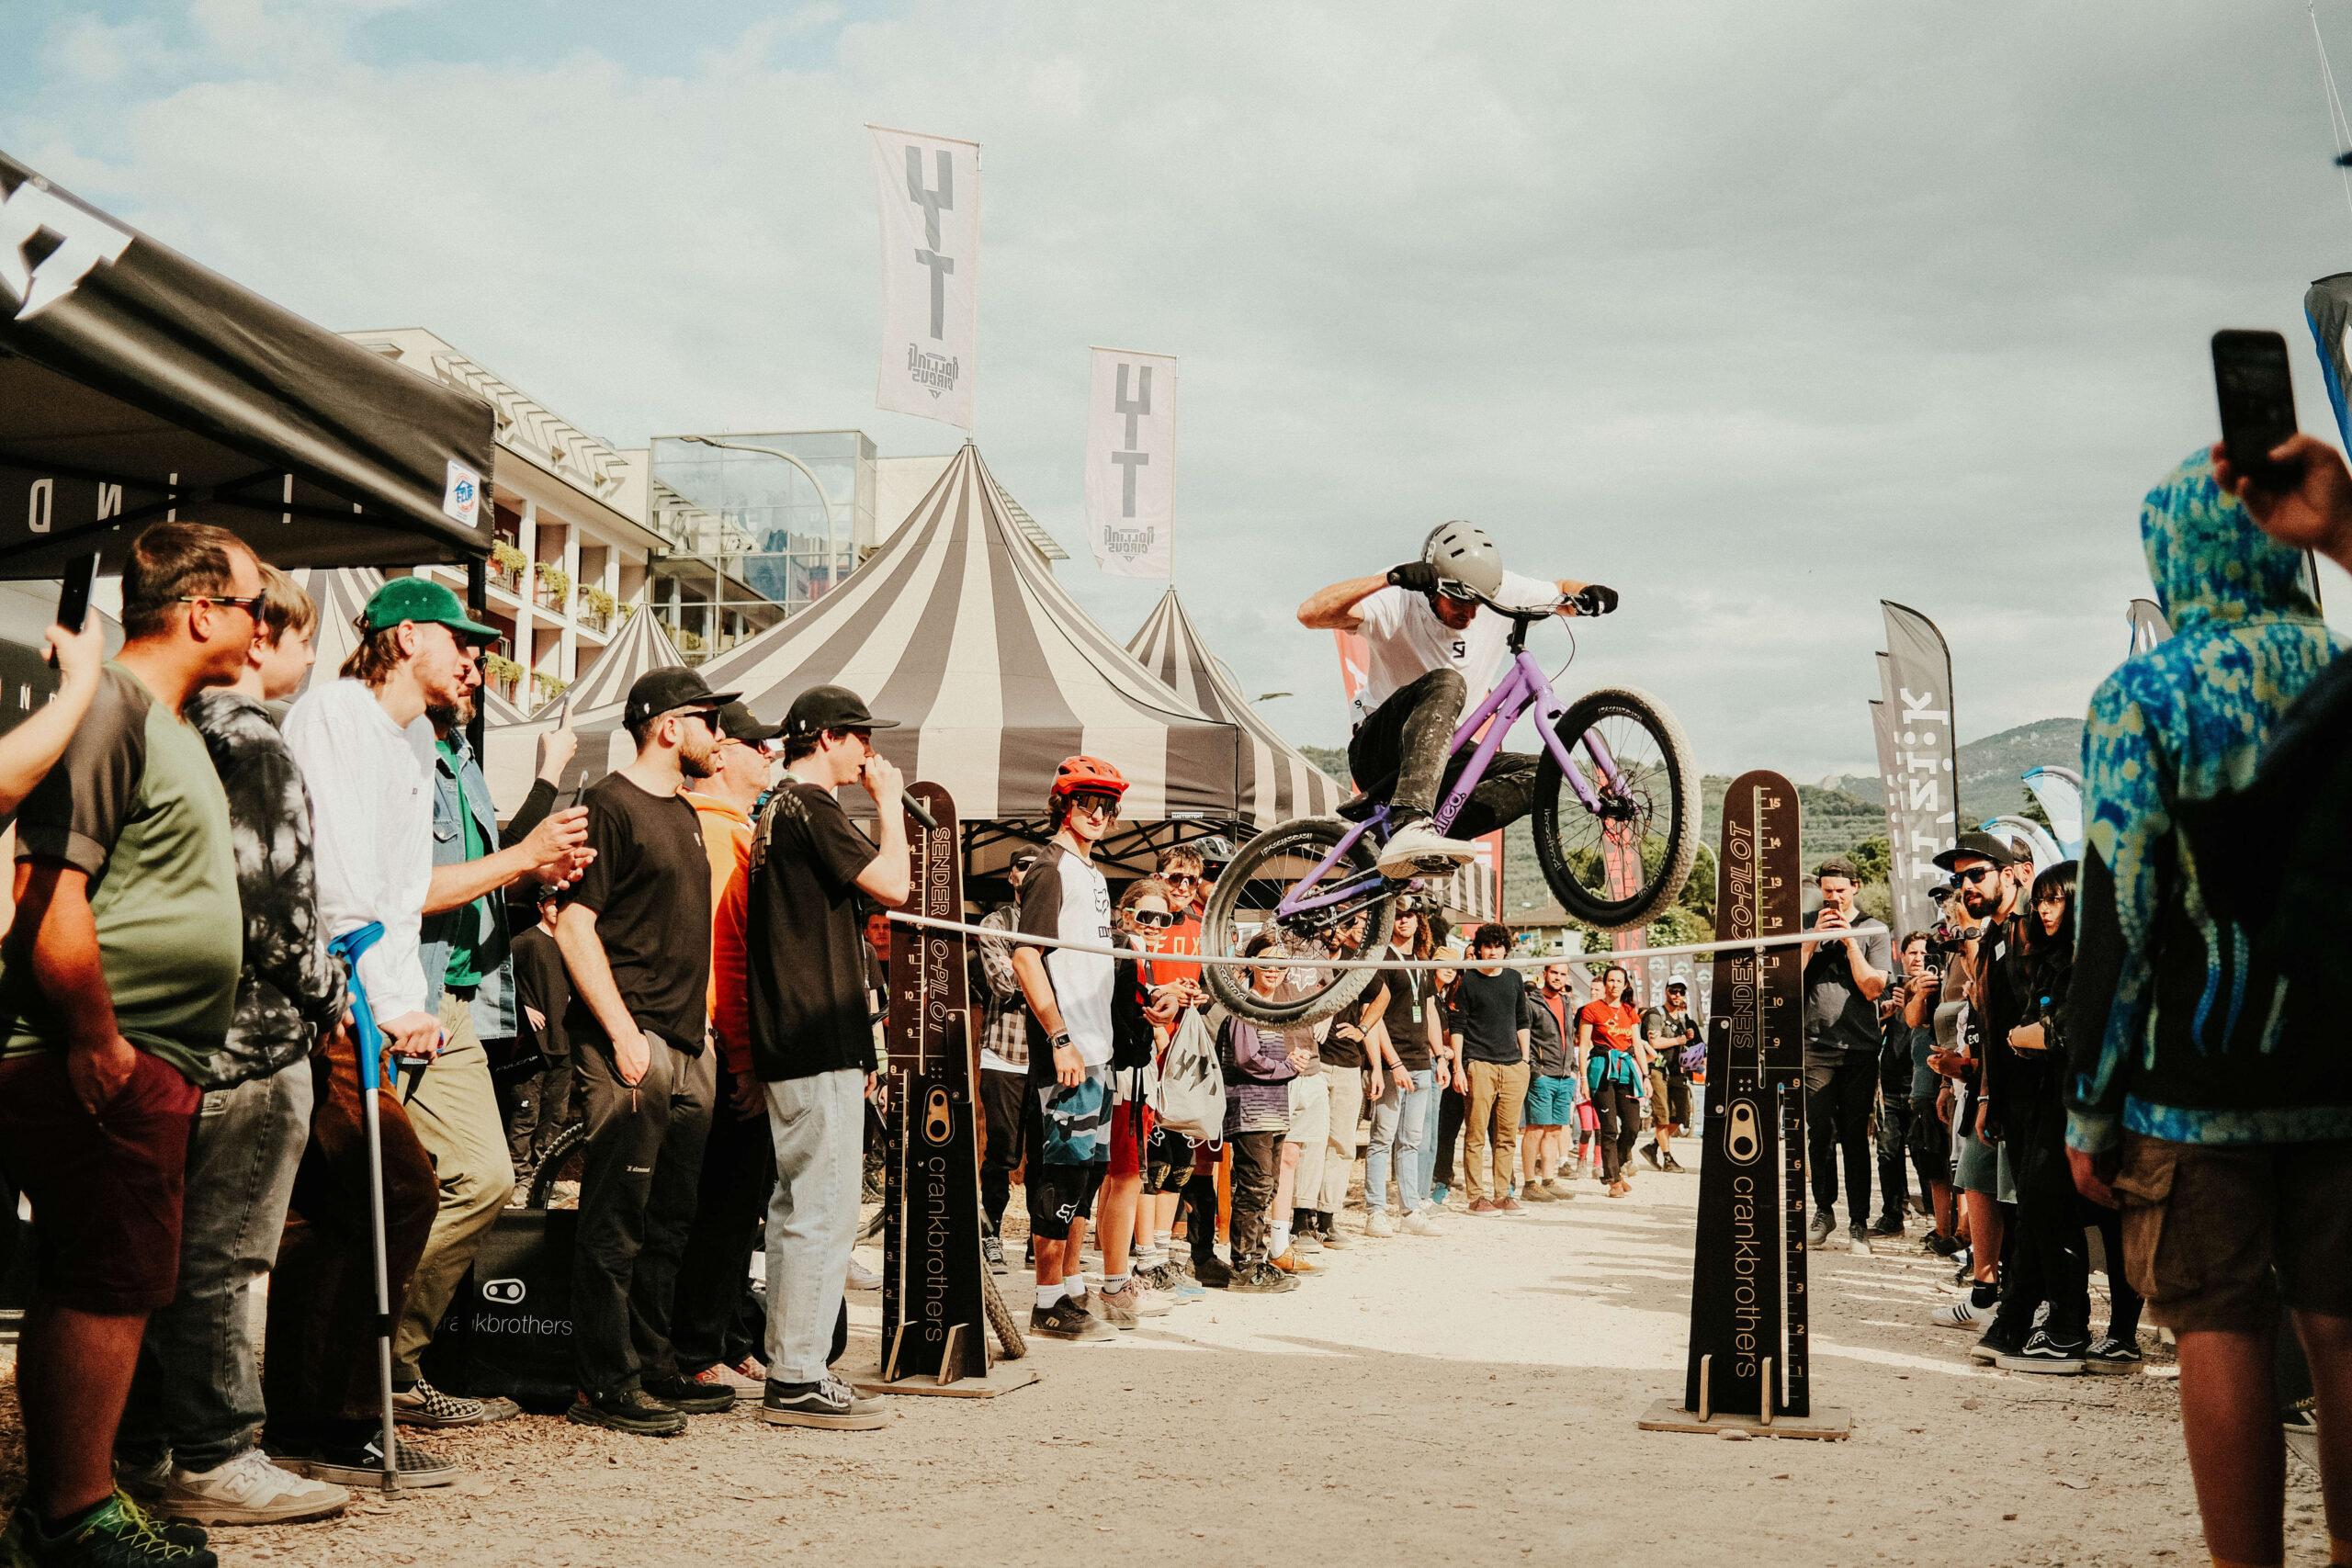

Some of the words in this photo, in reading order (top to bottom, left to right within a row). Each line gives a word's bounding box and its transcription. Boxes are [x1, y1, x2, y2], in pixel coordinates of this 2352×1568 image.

[1770, 797, 1781, 808] 15
[1770, 837, 1781, 847] 14
[931, 828, 951, 916] SENDER
[1729, 820, 1753, 941] CO-PILOT
[1770, 877, 1782, 887] 13
[1771, 917, 1783, 927] 12
[1153, 936, 1201, 955] FOX
[908, 954, 915, 963] 11
[1771, 956, 1780, 966] 11
[930, 935, 949, 1033] O-PILO
[904, 991, 914, 999] 10
[1732, 953, 1754, 1049] SENDER
[1772, 997, 1784, 1007] 10
[907, 1028, 913, 1037] 9
[1773, 1037, 1781, 1046] 9
[890, 1065, 897, 1074] 8
[1792, 1077, 1801, 1088] 8
[1793, 1119, 1800, 1128] 7
[889, 1139, 895, 1147] 6
[1793, 1159, 1802, 1169] 6
[888, 1177, 895, 1185] 5
[1795, 1201, 1803, 1210] 5
[887, 1213, 894, 1223] 4
[925, 1156, 951, 1342] crankbrothers
[1795, 1242, 1804, 1251] 4
[887, 1252, 893, 1260] 3
[1733, 1176, 1762, 1378] crankbrothers
[1796, 1282, 1804, 1292] 3
[437, 1313, 572, 1336] rakbrothers
[1797, 1325, 1804, 1334] 2
